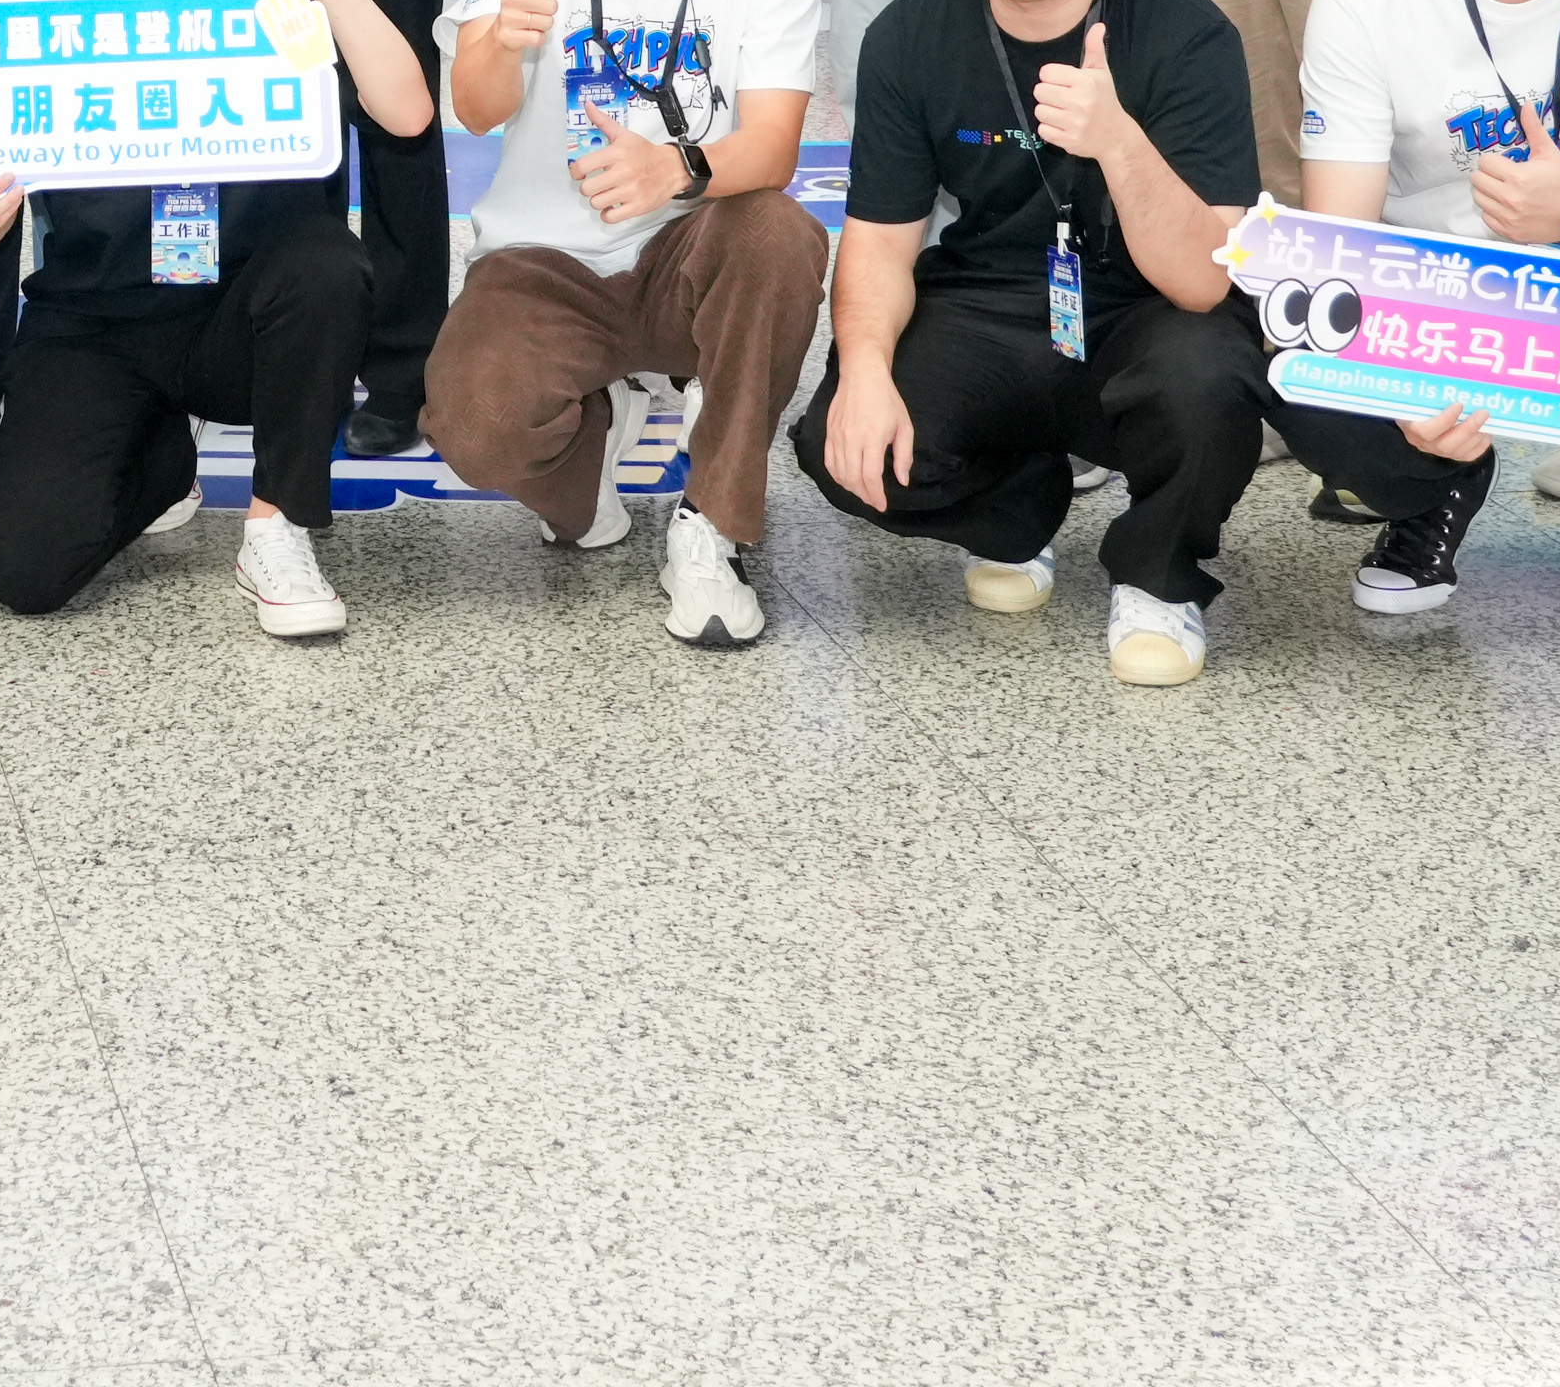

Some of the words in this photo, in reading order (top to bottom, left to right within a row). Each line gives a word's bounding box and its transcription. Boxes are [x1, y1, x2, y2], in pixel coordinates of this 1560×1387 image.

[74, 142, 100, 161] to
[109, 141, 172, 165] your
[182, 133, 312, 157] Moments
[159, 222, 210, 239] 工作证
[1052, 290, 1078, 309] 工作证
[1292, 361, 1411, 398] Happiness
[1418, 381, 1436, 399] is
[1443, 388, 1513, 417] Ready
[1520, 398, 1555, 419] for
